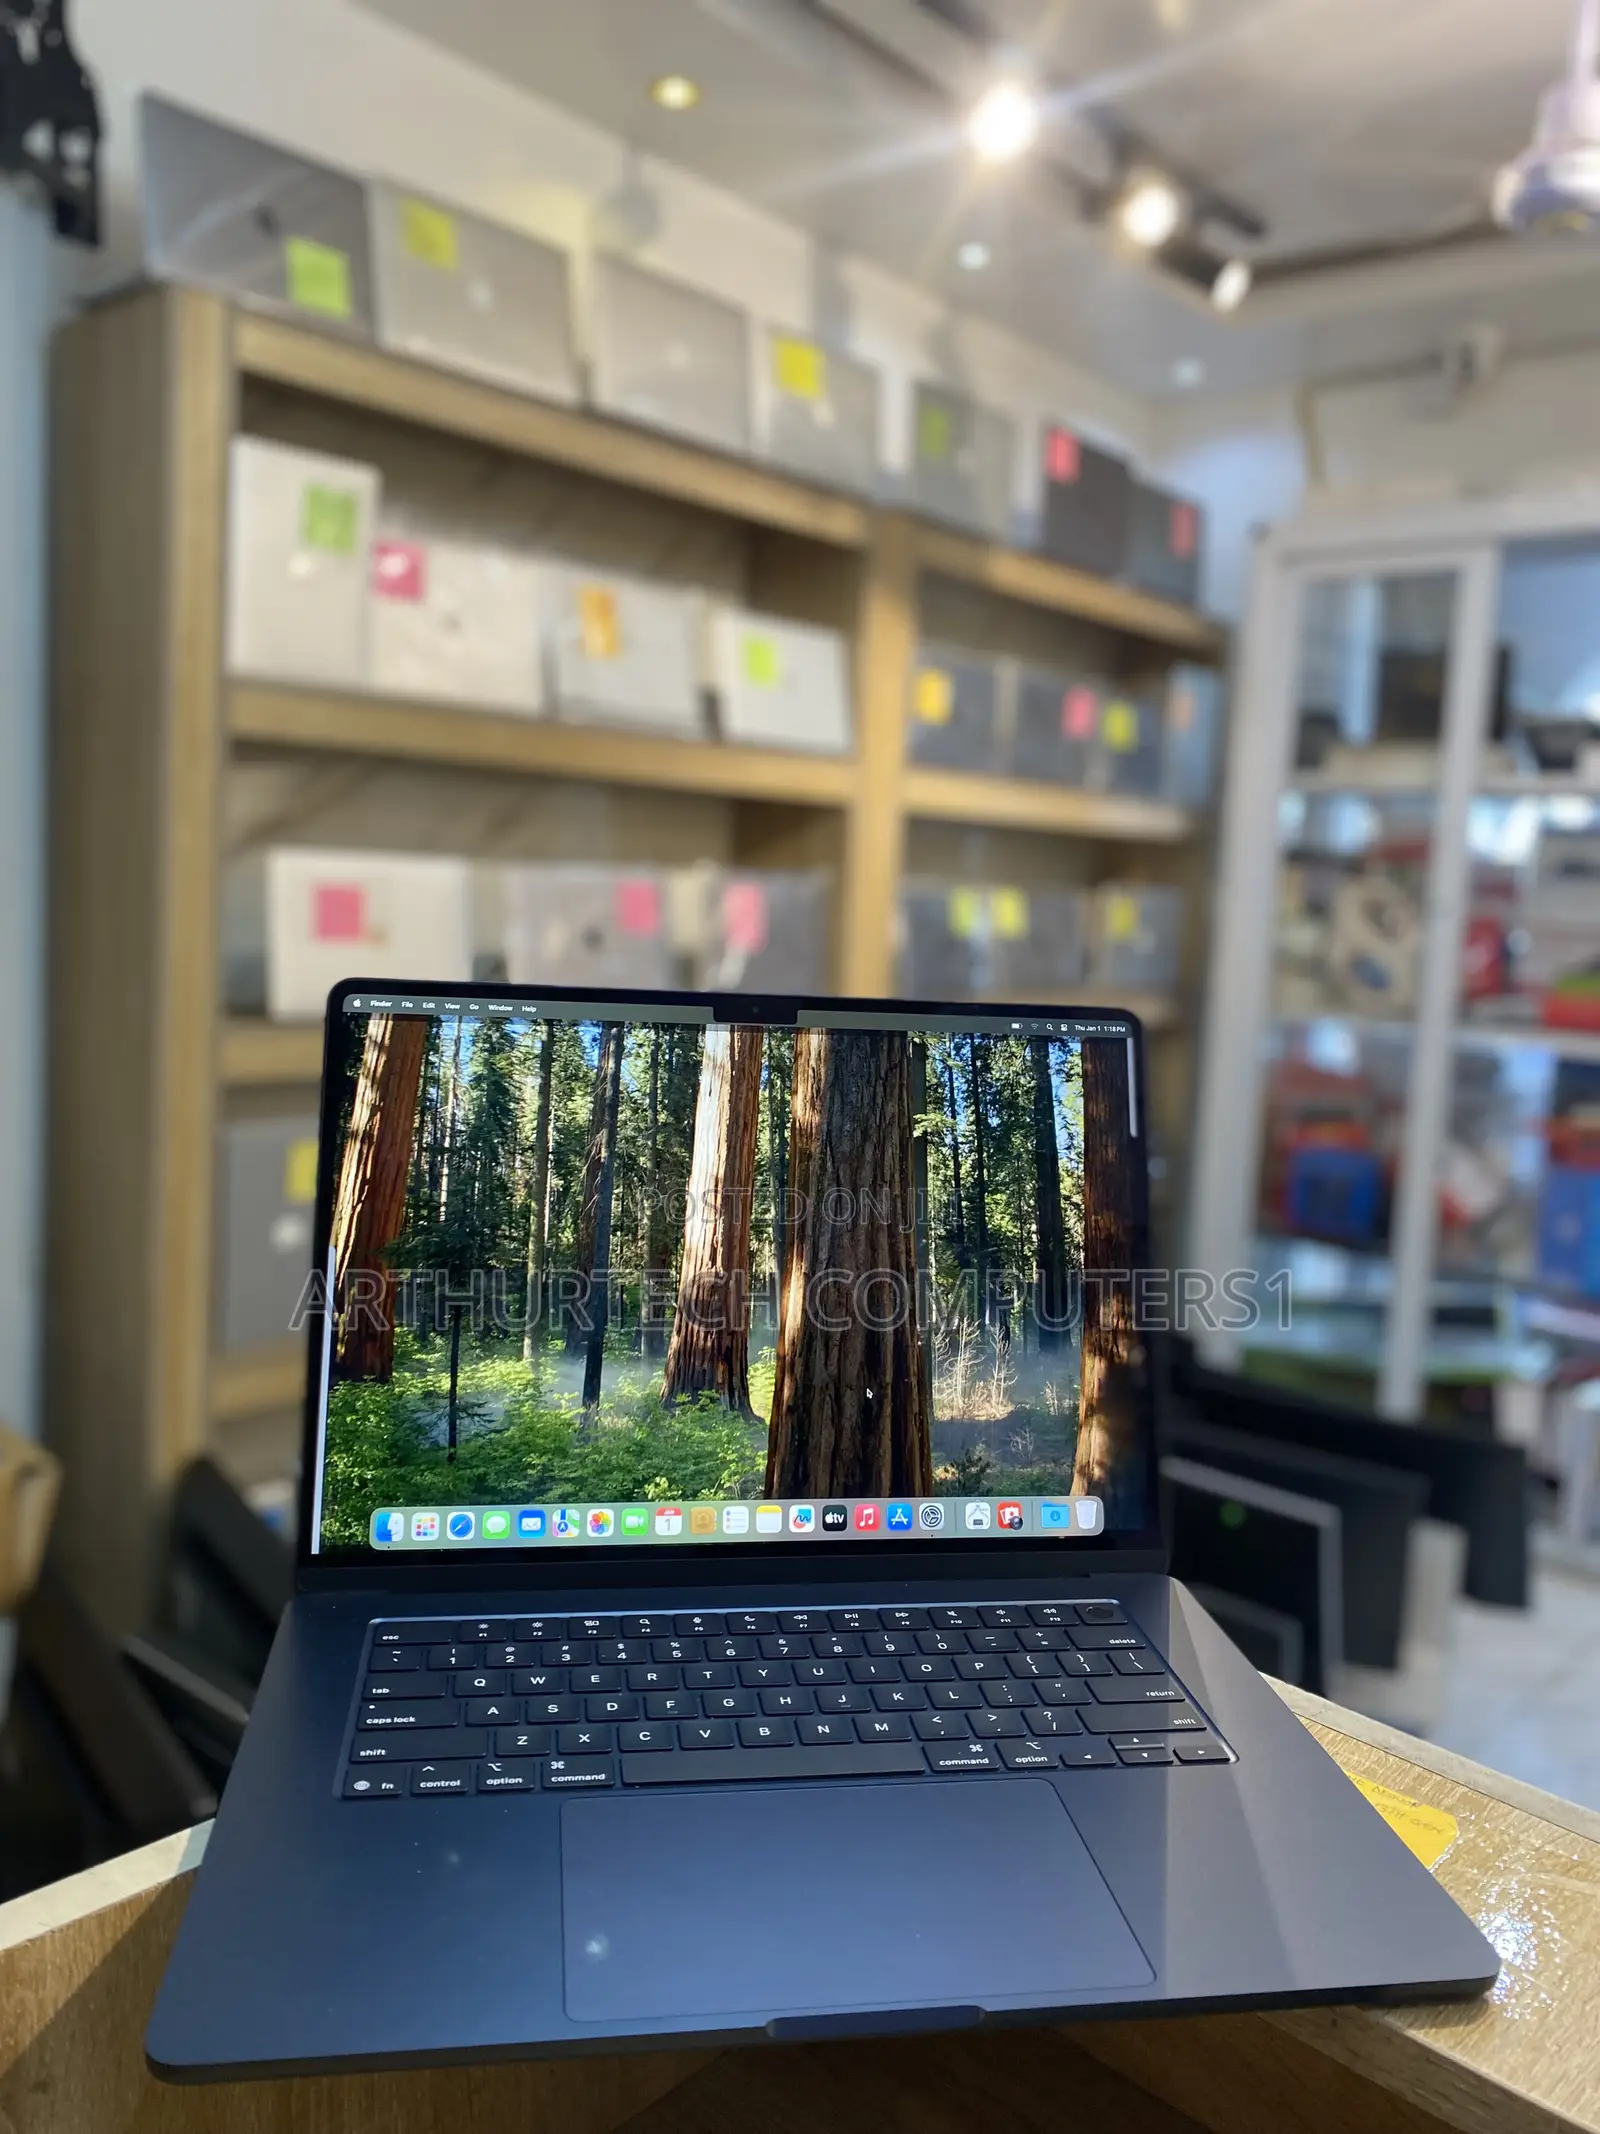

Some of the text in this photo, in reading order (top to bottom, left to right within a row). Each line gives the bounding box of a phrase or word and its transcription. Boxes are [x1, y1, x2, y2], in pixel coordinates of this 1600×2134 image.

[370, 1000, 392, 1008] Finder
[469, 1003, 480, 1011] Go
[488, 1004, 514, 1012] Window
[521, 1005, 537, 1013] Help
[779, 1646, 789, 1655] 7
[832, 1645, 844, 1653] 8
[884, 1643, 896, 1652] 9
[937, 1642, 948, 1650] 0
[616, 1651, 627, 1660] 4
[671, 1649, 683, 1658] 5
[725, 1648, 737, 1657] 6
[448, 1656, 457, 1665] 1
[505, 1654, 515, 1663] 2
[560, 1653, 572, 1662] 3
[870, 1665, 876, 1674] I
[920, 1663, 933, 1672] O
[974, 1662, 985, 1671] P
[702, 1670, 713, 1680] T
[757, 1668, 769, 1678] Y
[812, 1667, 825, 1676] U
[529, 1676, 547, 1685] W
[590, 1674, 601, 1683] E
[646, 1672, 658, 1681] R
[473, 1677, 487, 1688] Q
[837, 1694, 847, 1703] J
[892, 1692, 905, 1701] K
[948, 1690, 960, 1700] L
[665, 1700, 676, 1709] F
[722, 1698, 735, 1707] G
[779, 1696, 792, 1705] H
[486, 1706, 500, 1715] A
[547, 1704, 559, 1714] S
[606, 1702, 619, 1711] D
[365, 1715, 416, 1726] caps lock
[1172, 1717, 1197, 1725] shift
[758, 1726, 771, 1736] B
[816, 1724, 831, 1734] N
[874, 1722, 890, 1732] M
[578, 1733, 591, 1743] X
[638, 1731, 652, 1741] C
[698, 1728, 711, 1739] V
[516, 1735, 529, 1746] Z
[359, 1748, 387, 1757] shift
[938, 1757, 990, 1767] command
[1014, 1755, 1049, 1765] option
[485, 1776, 524, 1787] option
[550, 1772, 606, 1783] command
[381, 1781, 395, 1790] fn
[419, 1778, 461, 1789] control
